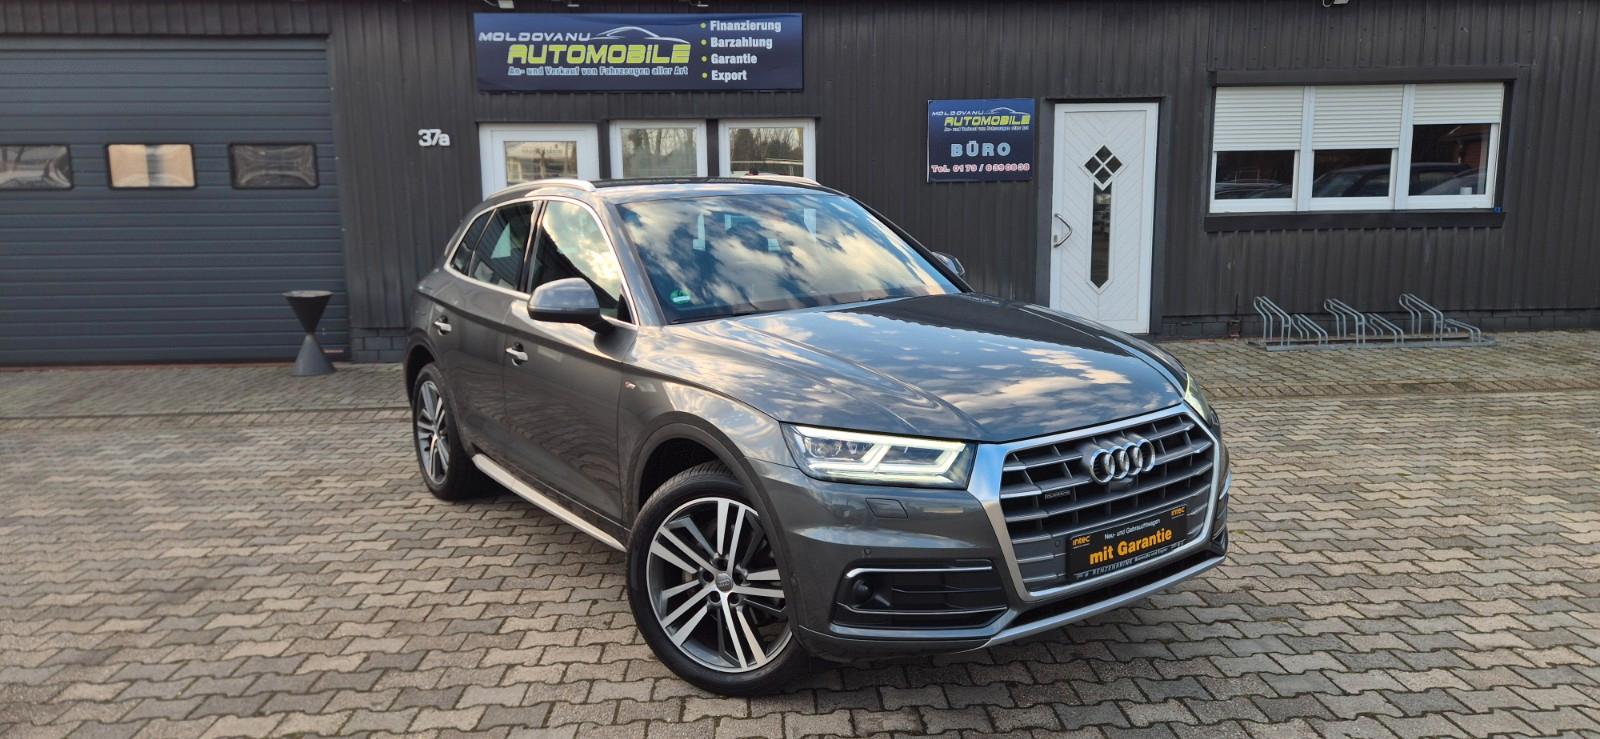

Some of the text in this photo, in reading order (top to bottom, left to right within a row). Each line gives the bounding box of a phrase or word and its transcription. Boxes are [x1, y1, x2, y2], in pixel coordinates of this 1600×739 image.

[710, 20, 782, 32] Finanzierung
[478, 31, 591, 42] MOLDOVANU
[710, 36, 773, 49] Barzahlung
[507, 44, 692, 64] AUTOMOBILE
[710, 53, 758, 64] Garantie
[526, 66, 544, 75] und
[545, 66, 579, 76] Verkauf
[581, 67, 598, 75] von
[599, 66, 650, 77] Fahrzeugen
[673, 66, 689, 75] Art
[711, 69, 748, 83] Export
[944, 115, 1030, 126] AUTOMOBILE
[417, 128, 451, 146] 37a
[950, 140, 1011, 157] BÜRO
[1089, 545, 1115, 565] mit
[1117, 528, 1172, 556] Garantie
